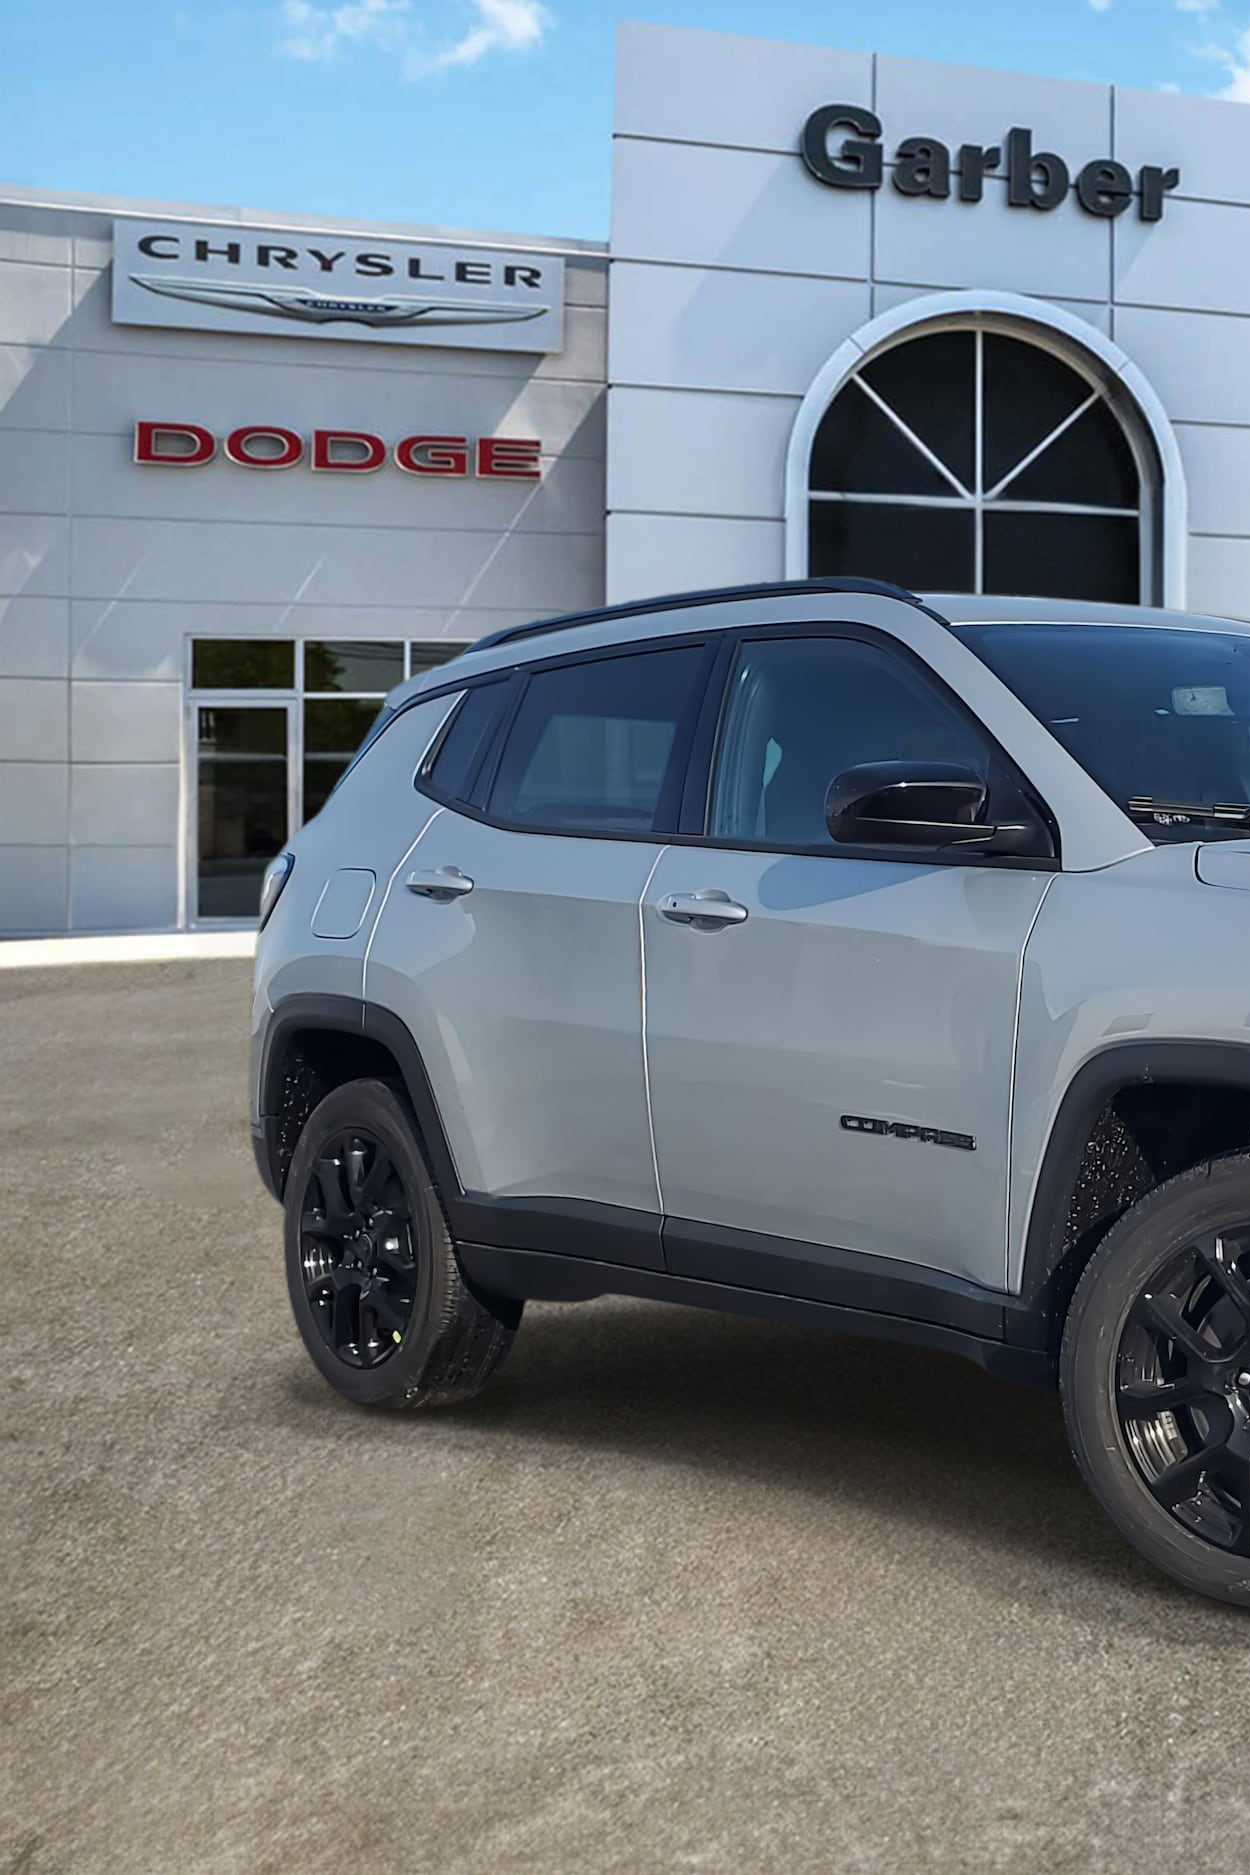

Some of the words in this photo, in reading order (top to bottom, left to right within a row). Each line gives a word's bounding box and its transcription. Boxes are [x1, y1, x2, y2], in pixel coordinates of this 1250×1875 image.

[801, 104, 1180, 221] Garber
[138, 235, 542, 288] CHRYSLER
[133, 421, 542, 480] DODGE
